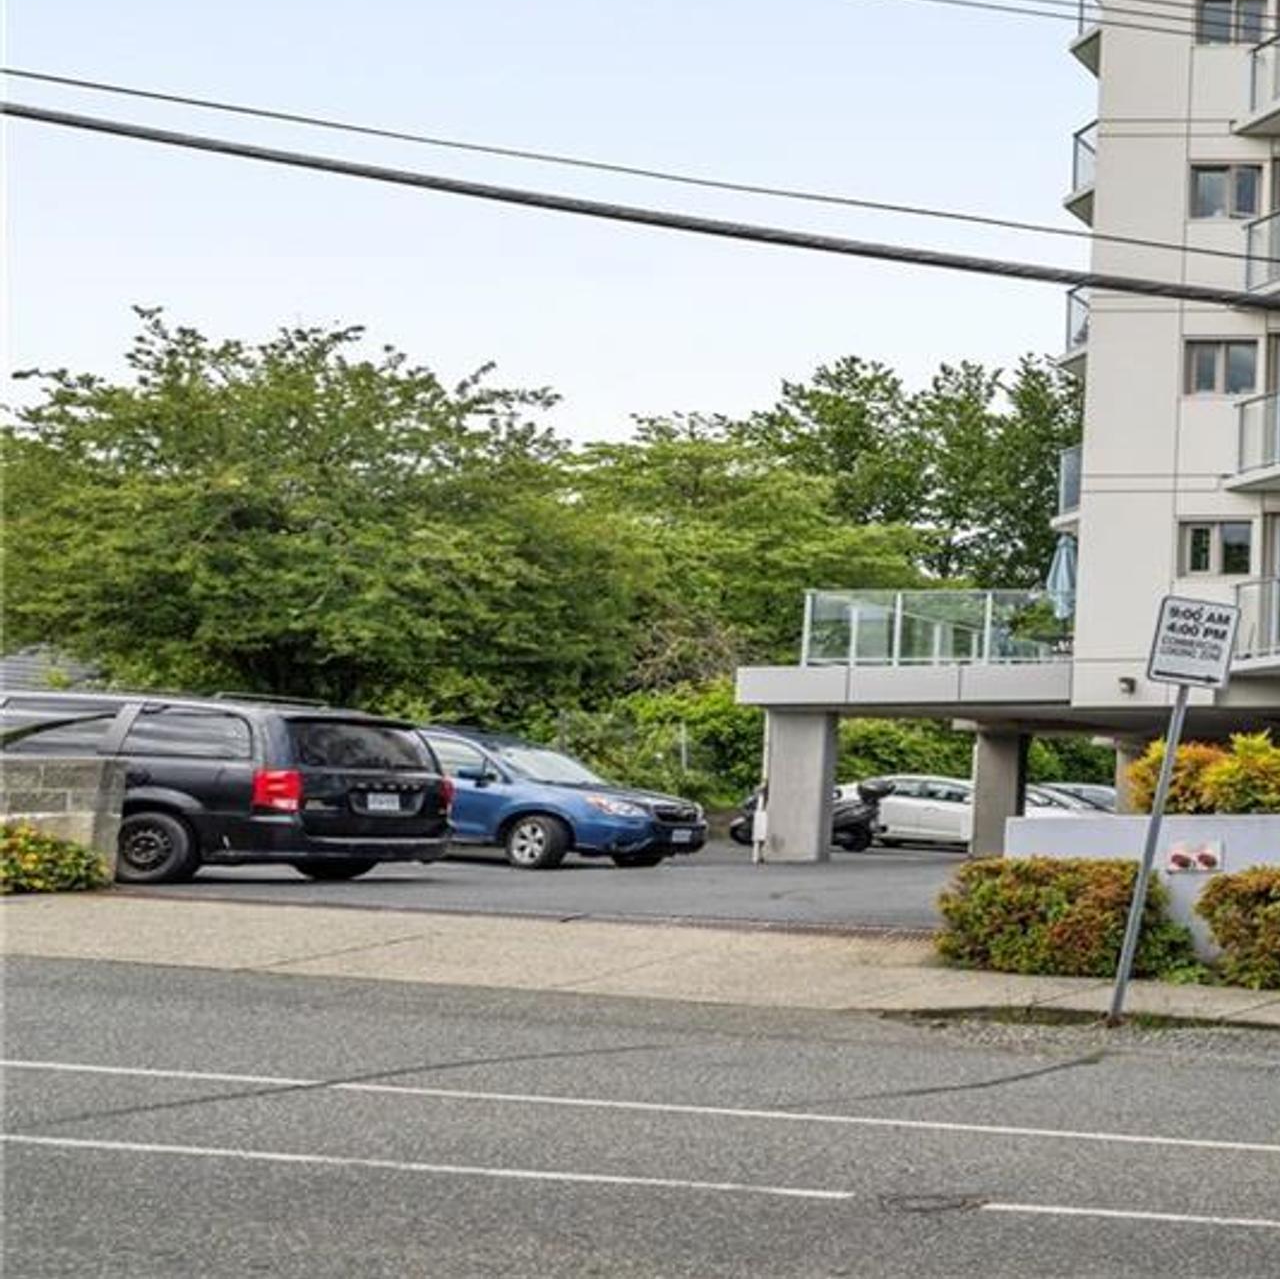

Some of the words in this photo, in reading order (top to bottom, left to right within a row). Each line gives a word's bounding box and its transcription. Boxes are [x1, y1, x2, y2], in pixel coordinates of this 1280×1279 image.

[1169, 606, 1202, 622] 9:00
[1205, 612, 1231, 625] AM
[1167, 622, 1200, 637] 4:00
[1203, 628, 1228, 640] PM
